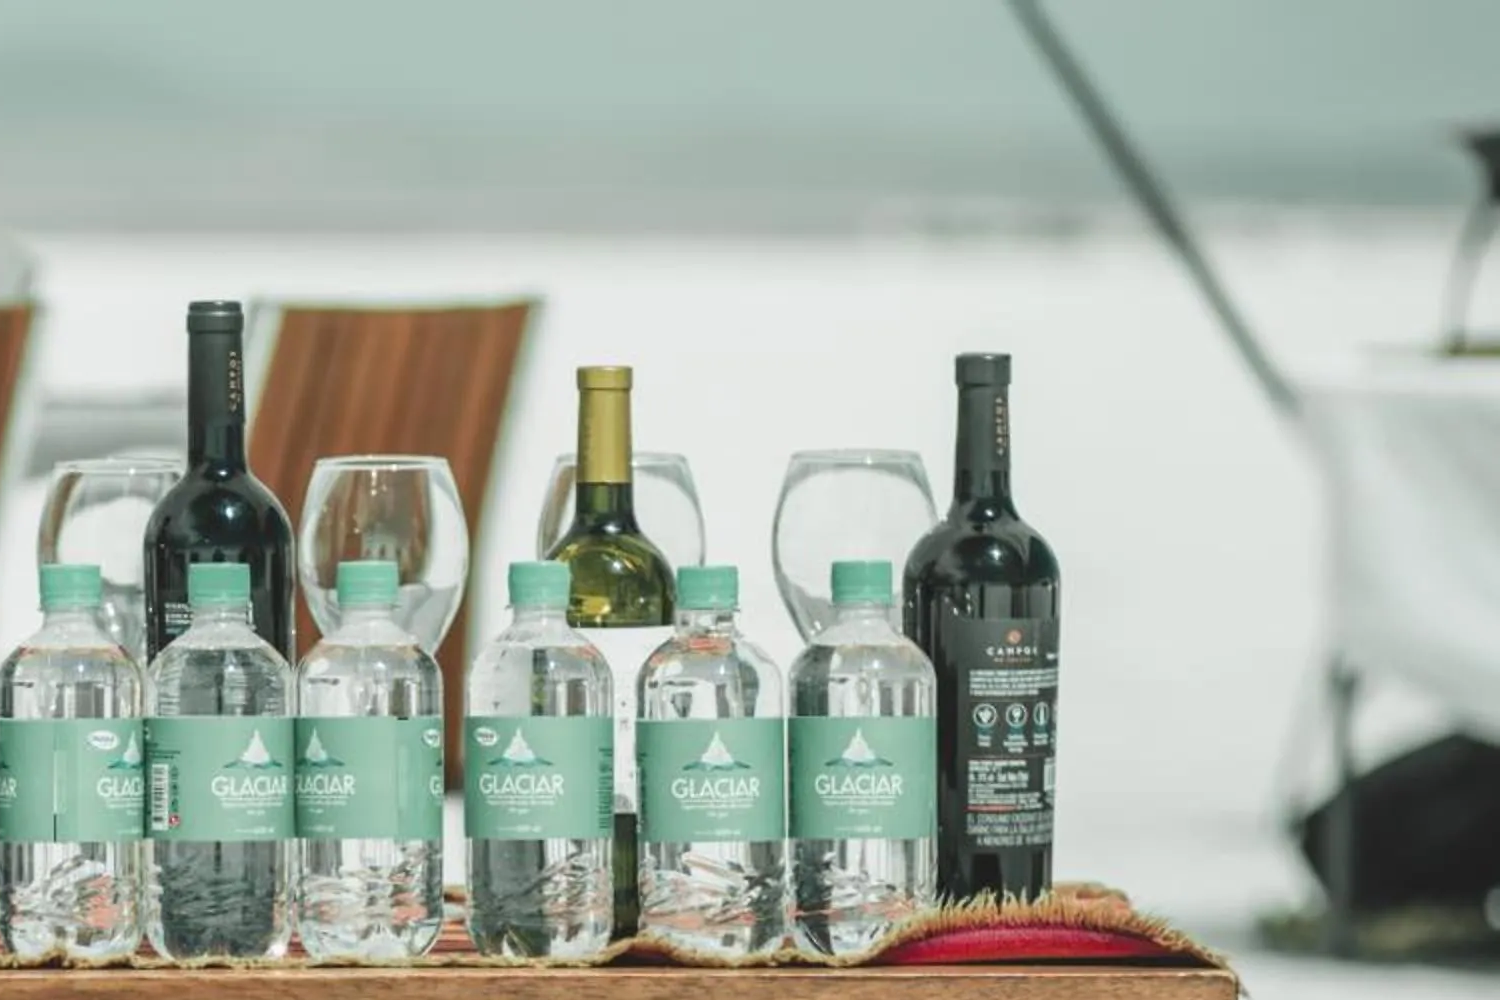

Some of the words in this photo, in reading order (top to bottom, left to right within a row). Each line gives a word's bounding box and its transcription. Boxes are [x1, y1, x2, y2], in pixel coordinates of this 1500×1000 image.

[479, 772, 565, 796] GLACIAR
[671, 777, 760, 800] GLACIAR
[814, 773, 904, 797] GLACIAR
